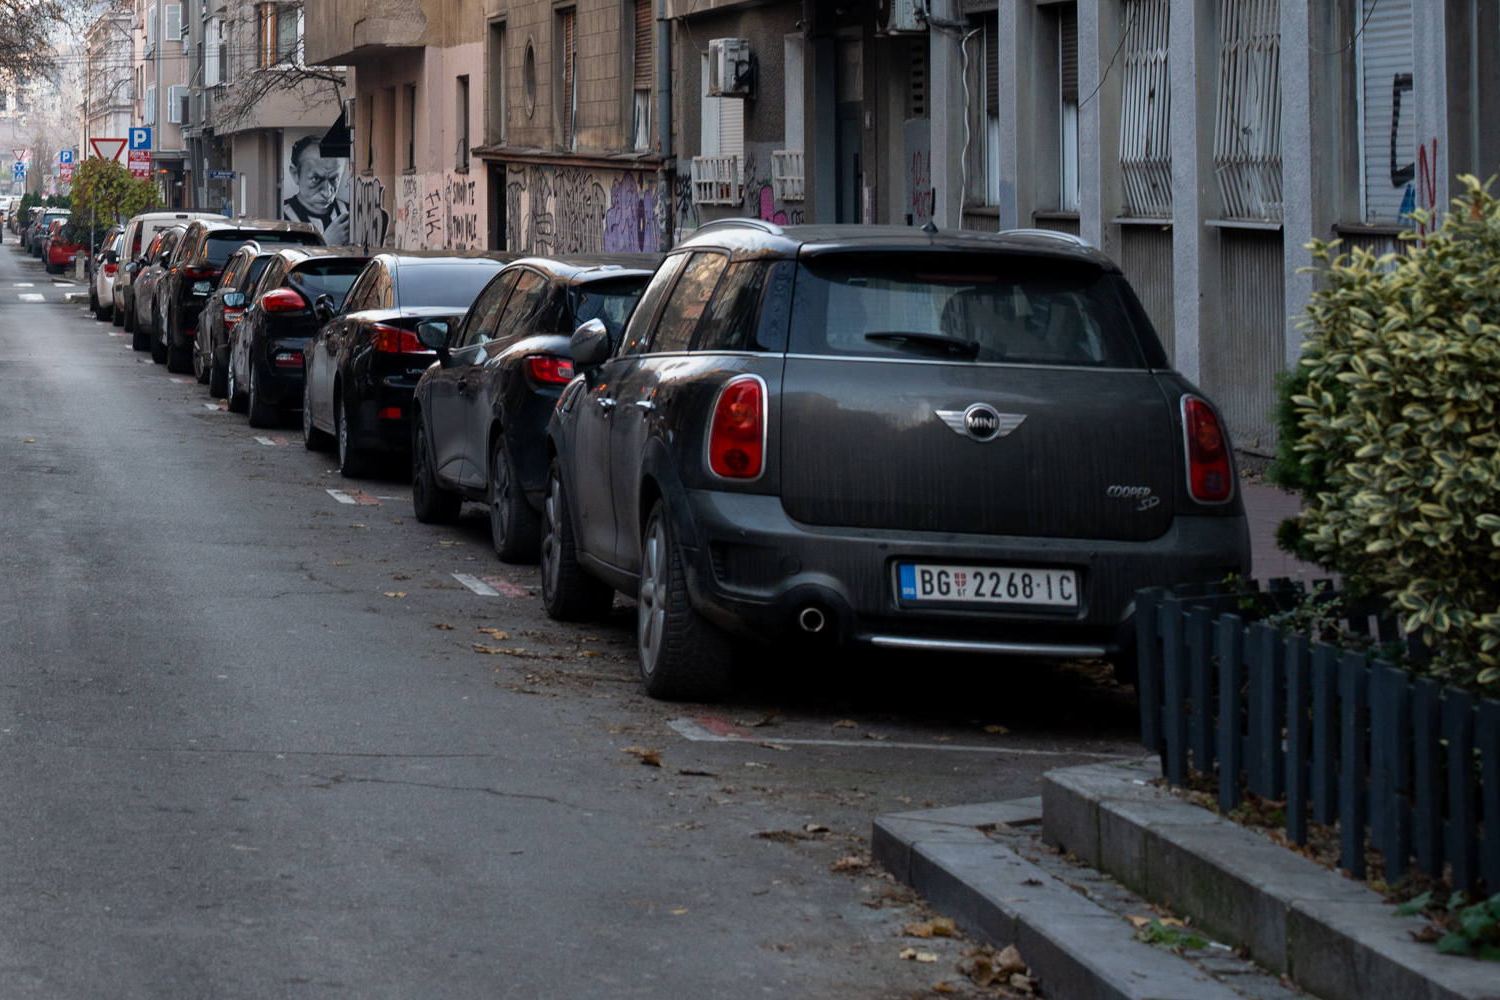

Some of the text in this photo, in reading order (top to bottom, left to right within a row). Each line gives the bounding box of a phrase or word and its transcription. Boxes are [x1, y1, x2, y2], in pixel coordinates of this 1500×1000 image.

[133, 130, 147, 148] P
[62, 151, 71, 162] P
[967, 416, 997, 430] MINI
[1107, 485, 1151, 498] COOPER
[920, 569, 950, 597] BG
